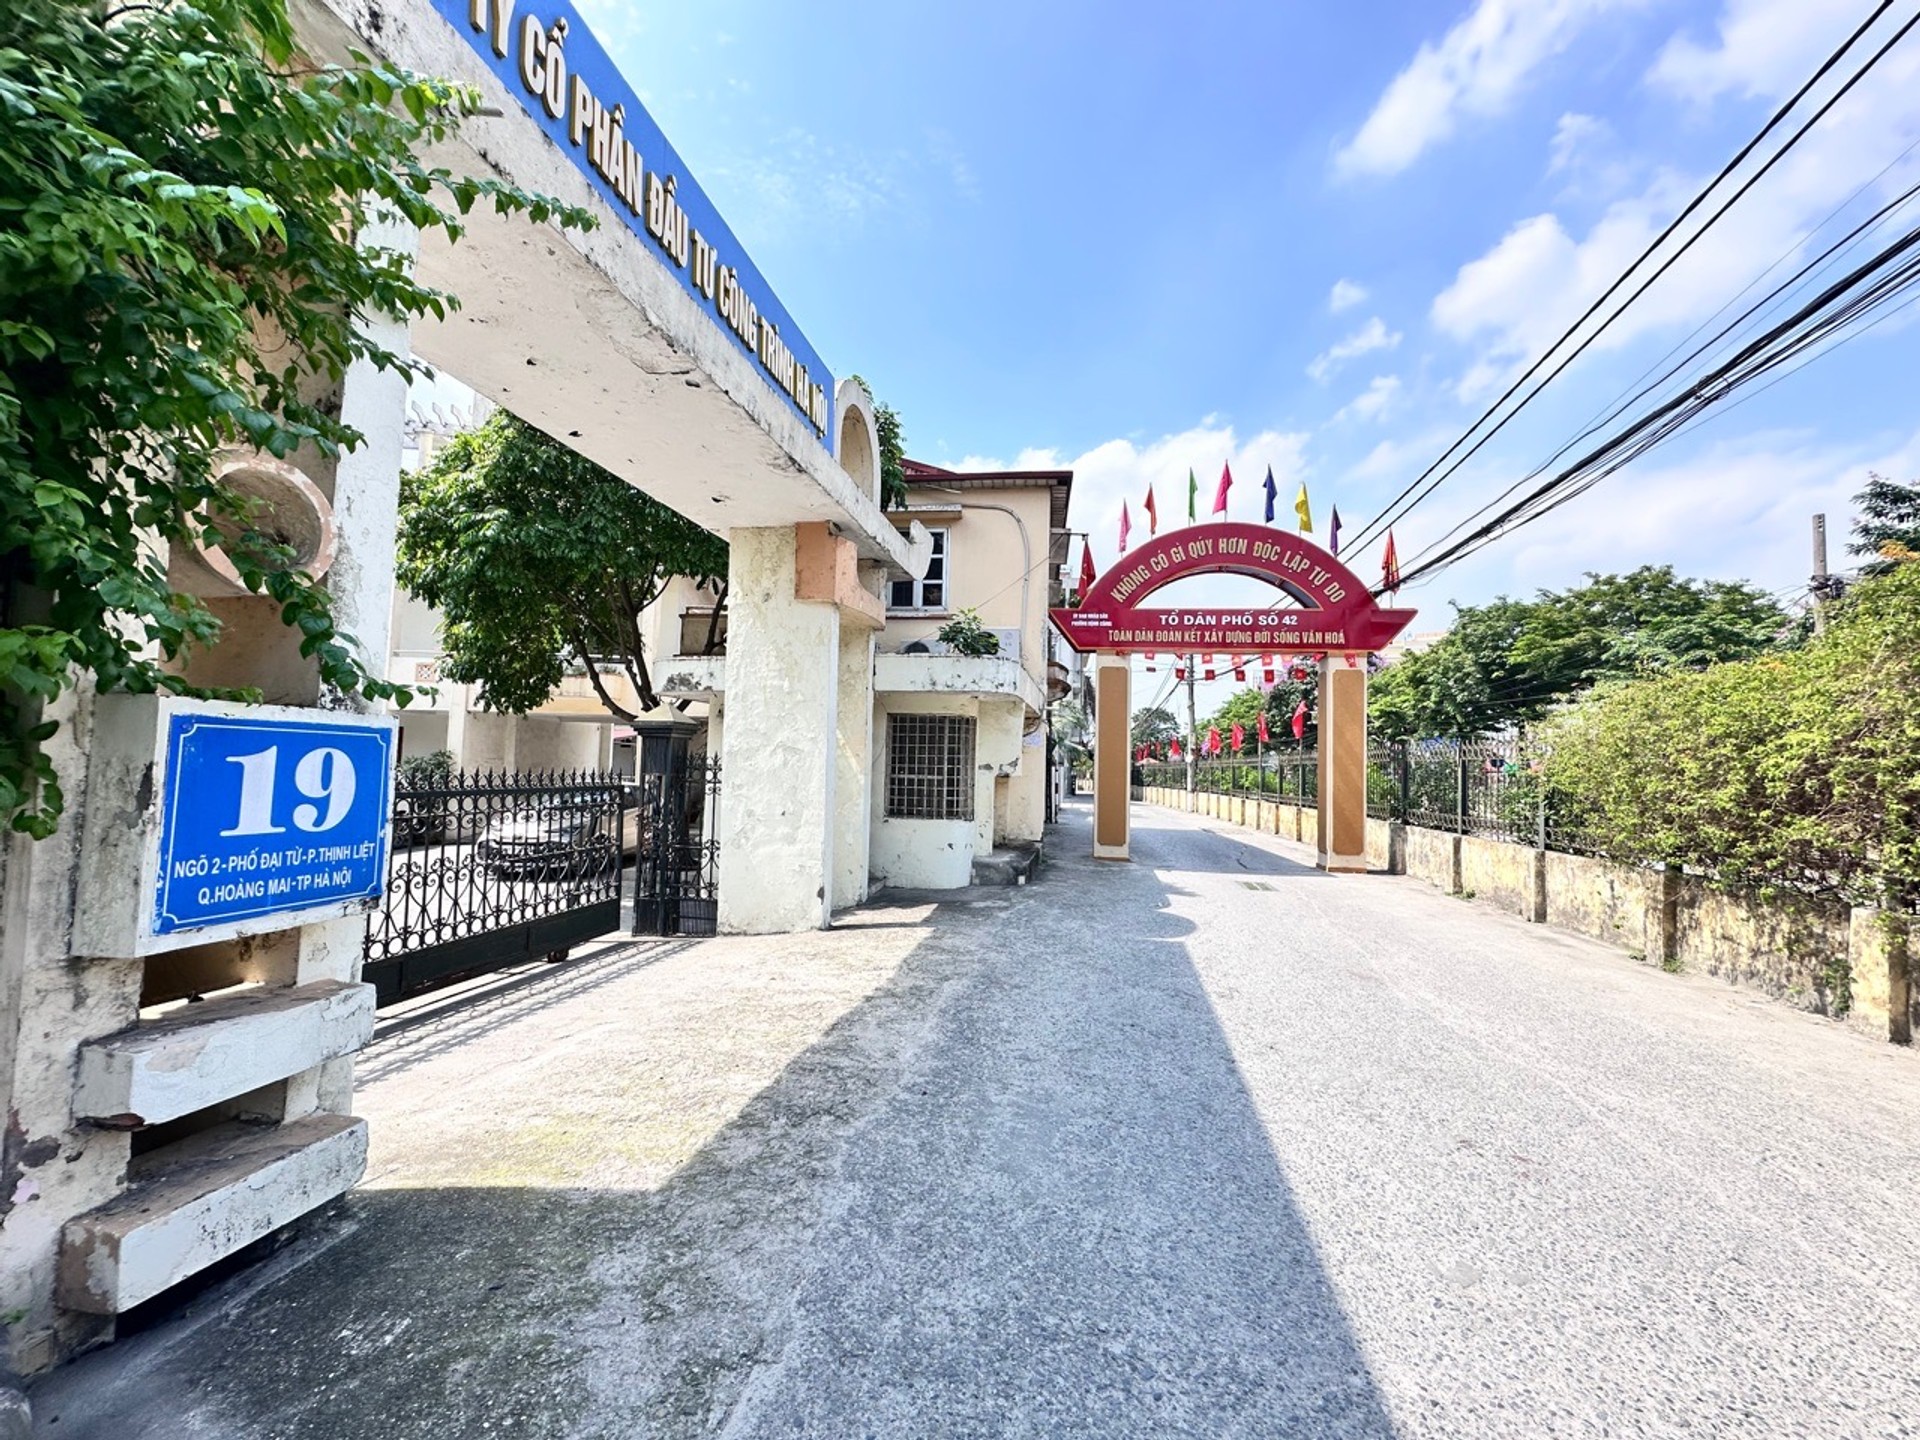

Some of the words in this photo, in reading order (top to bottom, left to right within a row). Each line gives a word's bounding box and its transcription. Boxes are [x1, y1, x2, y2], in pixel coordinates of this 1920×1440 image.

[520, 14, 569, 120] CỔ
[570, 73, 644, 217] PHẦN
[646, 173, 689, 268] ĐẦU
[690, 228, 718, 300] TƯ
[715, 264, 759, 354] CÔNG
[757, 315, 795, 397] TRÌNH
[793, 360, 809, 418] HÀ
[1110, 564, 1152, 604] KHÔNG
[1149, 549, 1170, 573] CÓ
[1170, 542, 1187, 564] GÌ
[1218, 537, 1249, 555] HƠN
[1252, 539, 1281, 563] ĐỘC
[1281, 550, 1311, 573] LẬP
[1307, 565, 1332, 588] TỰ
[1322, 581, 1346, 603] DO
[1108, 627, 1133, 642] TOÀN
[1134, 627, 1154, 642] DÂN
[1183, 626, 1202, 643] KẾT
[1204, 628, 1224, 644] XÂY
[1225, 630, 1253, 646] DỰNG
[1273, 627, 1301, 644] SỐNG
[1324, 628, 1346, 645] HOÁ
[1159, 609, 1180, 626] TỔ
[1183, 611, 1217, 626] DÂN
[1221, 610, 1254, 626] PHỐ
[1258, 610, 1279, 626] SỐ
[1282, 615, 1298, 626] 42
[219, 744, 357, 837] 19
[173, 854, 209, 879] NGÕ
[211, 848, 258, 875] 2-PHỐ
[259, 851, 283, 872] ĐẠI
[353, 841, 376, 862] LIỆT
[198, 877, 265, 905] Q.HOÀNG
[267, 874, 312, 896] MAI-TP
[313, 867, 331, 889] HÀ
[332, 866, 353, 888] NỘI
